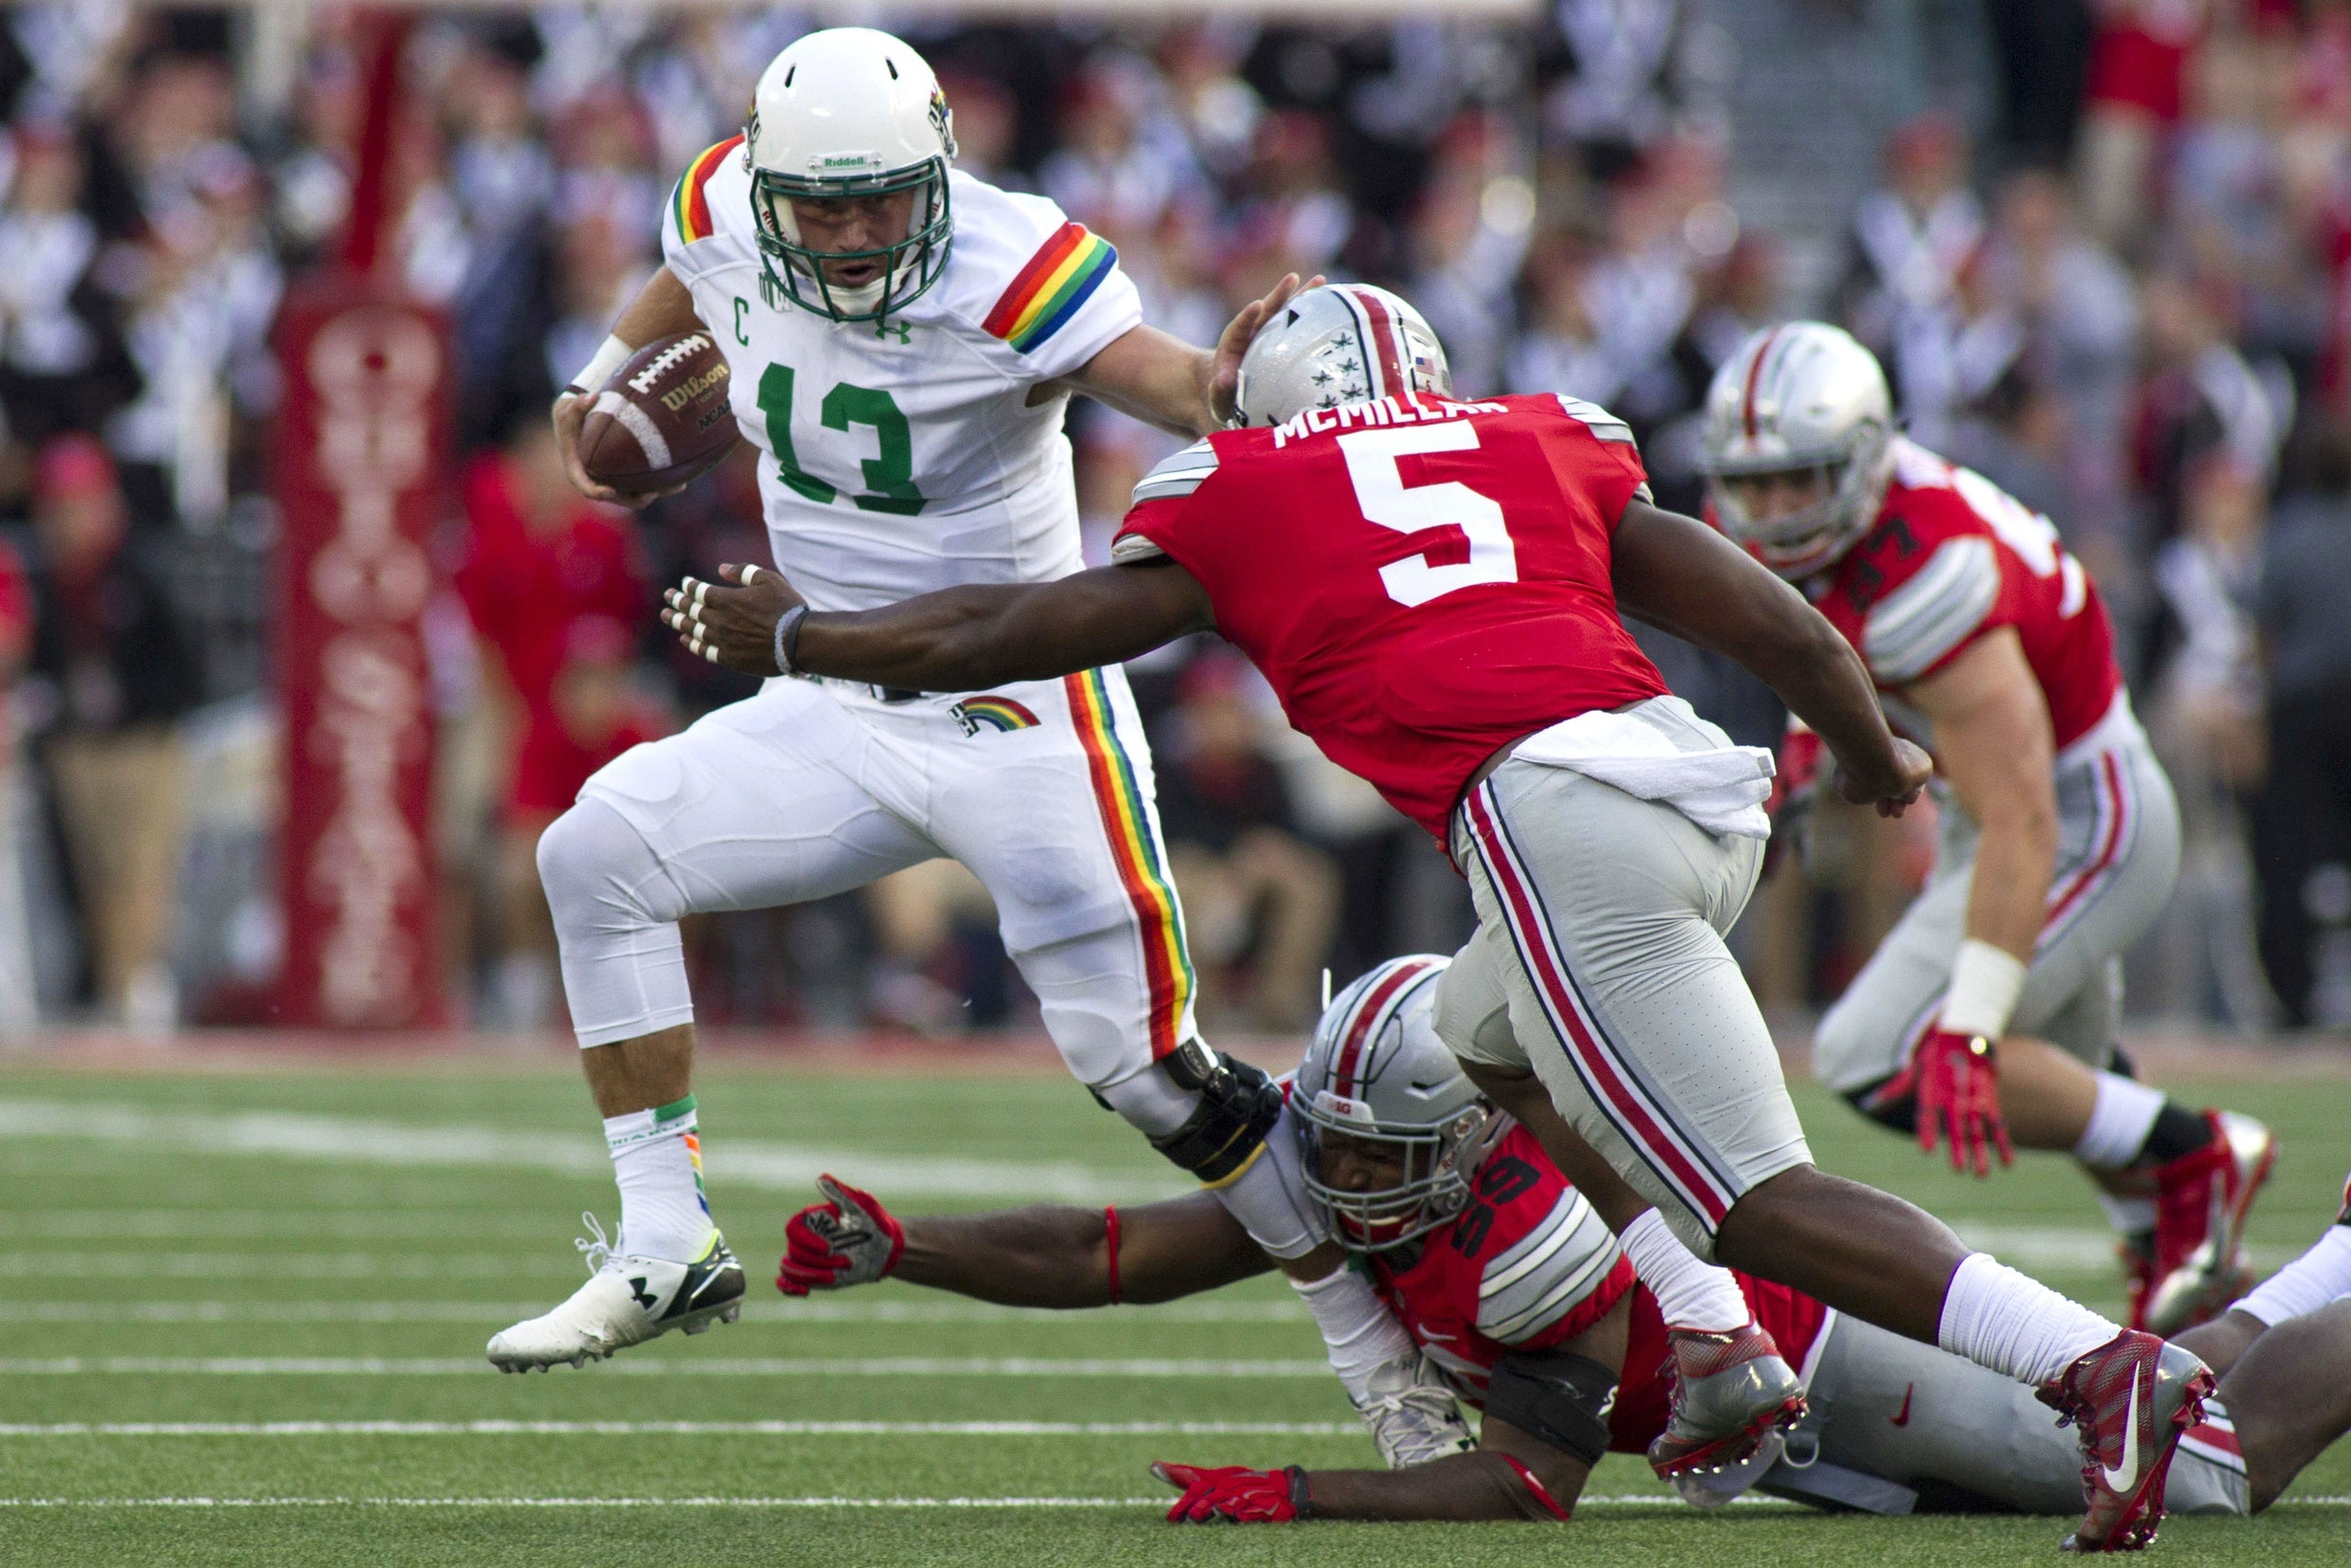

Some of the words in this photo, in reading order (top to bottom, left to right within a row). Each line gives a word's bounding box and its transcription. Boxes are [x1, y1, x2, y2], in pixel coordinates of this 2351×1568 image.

[825, 155, 865, 167] Riddell
[734, 296, 749, 347] C
[661, 363, 729, 411] Wilson
[756, 361, 928, 517] 13
[1336, 419, 1519, 608] 5
[1450, 1155, 1542, 1260] 59
